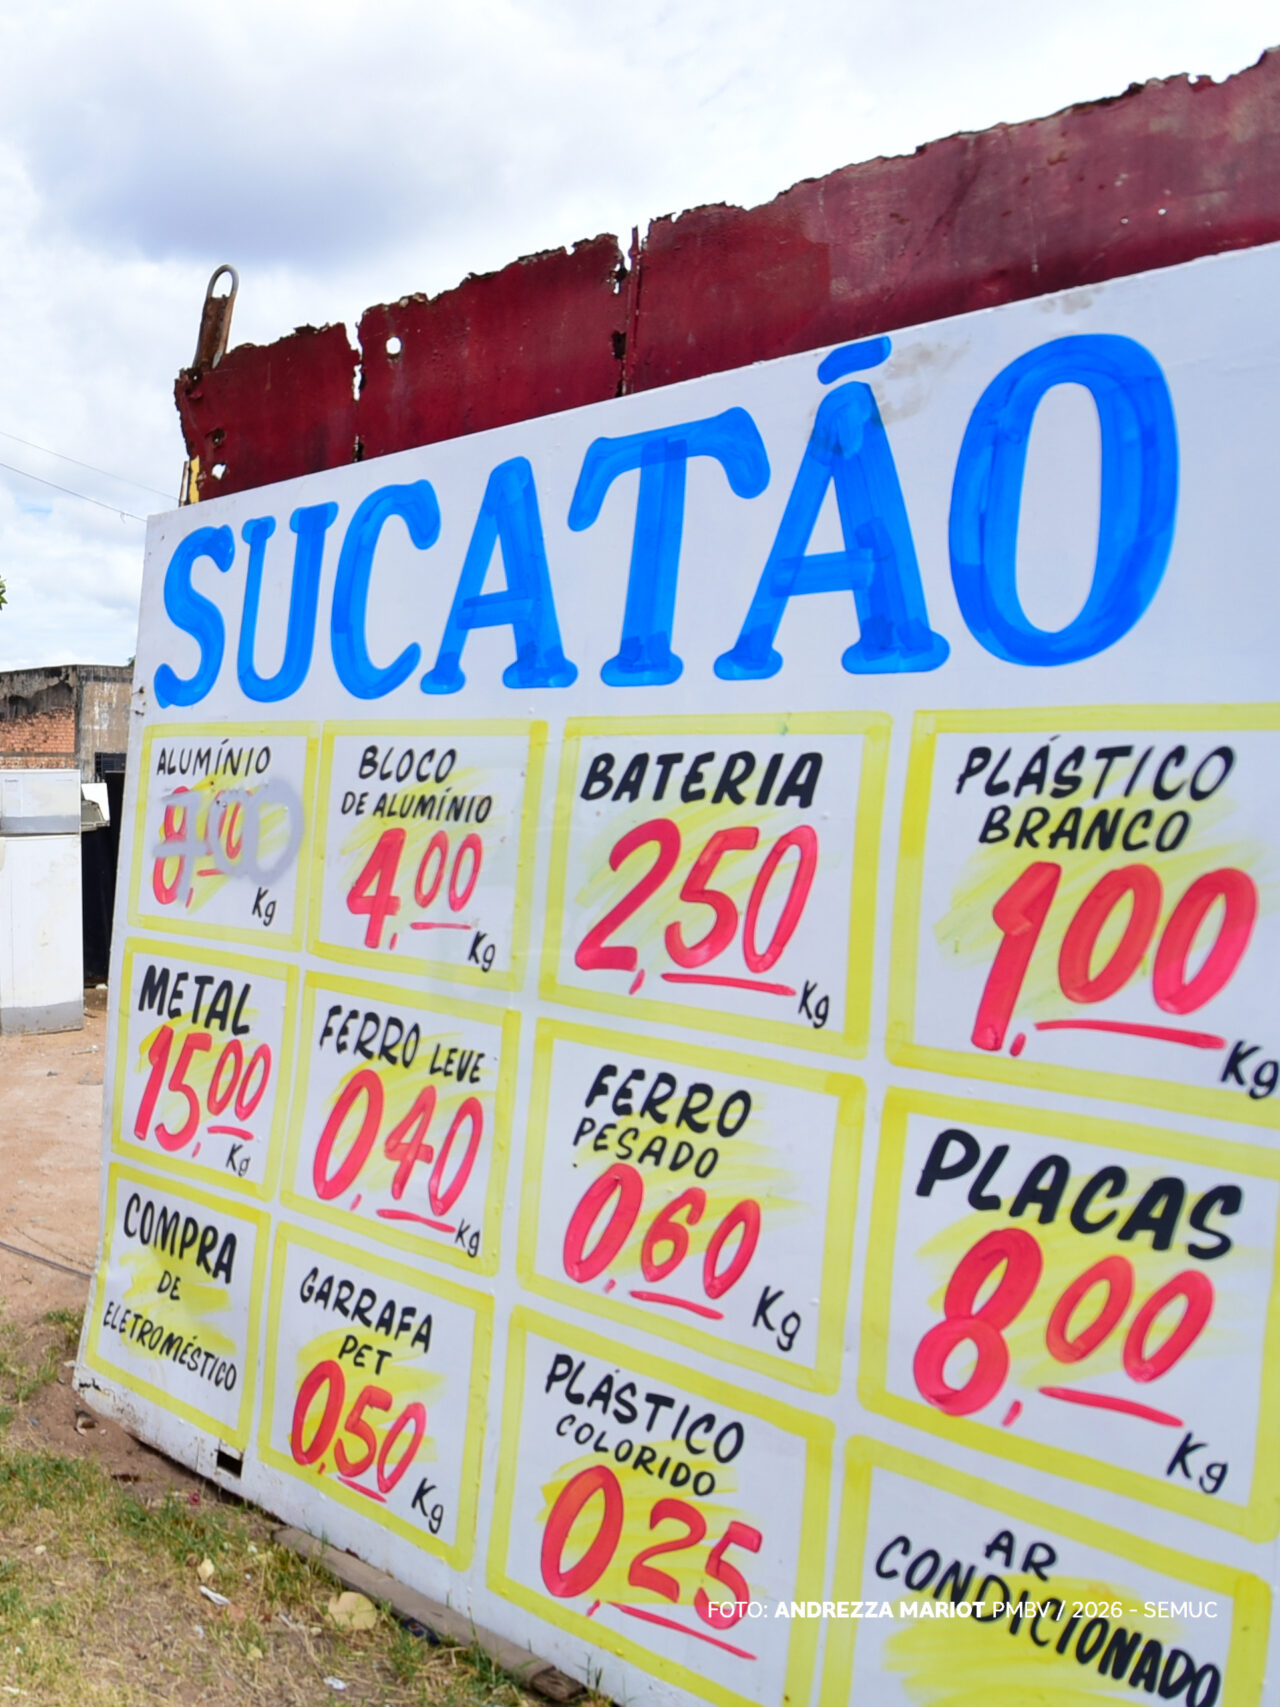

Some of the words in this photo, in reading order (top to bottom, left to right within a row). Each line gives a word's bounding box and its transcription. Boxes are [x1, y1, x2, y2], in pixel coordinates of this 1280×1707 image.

[155, 333, 1180, 709] SUCATÃO
[156, 739, 272, 776] ALUMÍNIO
[358, 745, 458, 783] BLOCO
[580, 751, 823, 809] BATERIA
[955, 735, 1236, 802] PLÁSTICO
[341, 791, 365, 816] DE
[373, 788, 492, 823] ALUMÍNIO
[978, 805, 1192, 852] BRANCO
[252, 886, 277, 926] Kg
[346, 827, 483, 950] 4,00
[467, 930, 496, 972] Kg
[574, 818, 819, 995] 2,50
[798, 979, 830, 1029] Kg
[138, 964, 252, 1036] METAL
[319, 1004, 422, 1069] FERRO
[428, 1043, 486, 1084] LEVE
[1220, 1040, 1280, 1100] Kg
[134, 1024, 272, 1159] 15,00
[225, 1143, 252, 1177] Kg
[584, 1063, 752, 1137] FERRO
[312, 1068, 484, 1217] 0,40
[455, 1218, 481, 1258] Kg
[572, 1116, 719, 1179] PESADO
[916, 1128, 1243, 1261] PLACAS
[123, 1193, 238, 1284] COMPRA
[563, 1162, 762, 1300] 0,60
[752, 1285, 802, 1352] Kg
[156, 1270, 182, 1301] DE
[299, 1267, 434, 1354] GARRAFA
[103, 1301, 238, 1392] ELETROMÉSTICO
[338, 1335, 392, 1376] PET
[913, 1227, 1215, 1428] 8,00
[1166, 1431, 1229, 1495] Kg
[290, 1359, 427, 1495] 0,50
[410, 1477, 444, 1534] Kg
[545, 1353, 745, 1464] PLÁSTICO
[556, 1414, 717, 1496] COLORIDO
[985, 1530, 1057, 1582] AR
[875, 1535, 1222, 1707] CONDICIONADO
